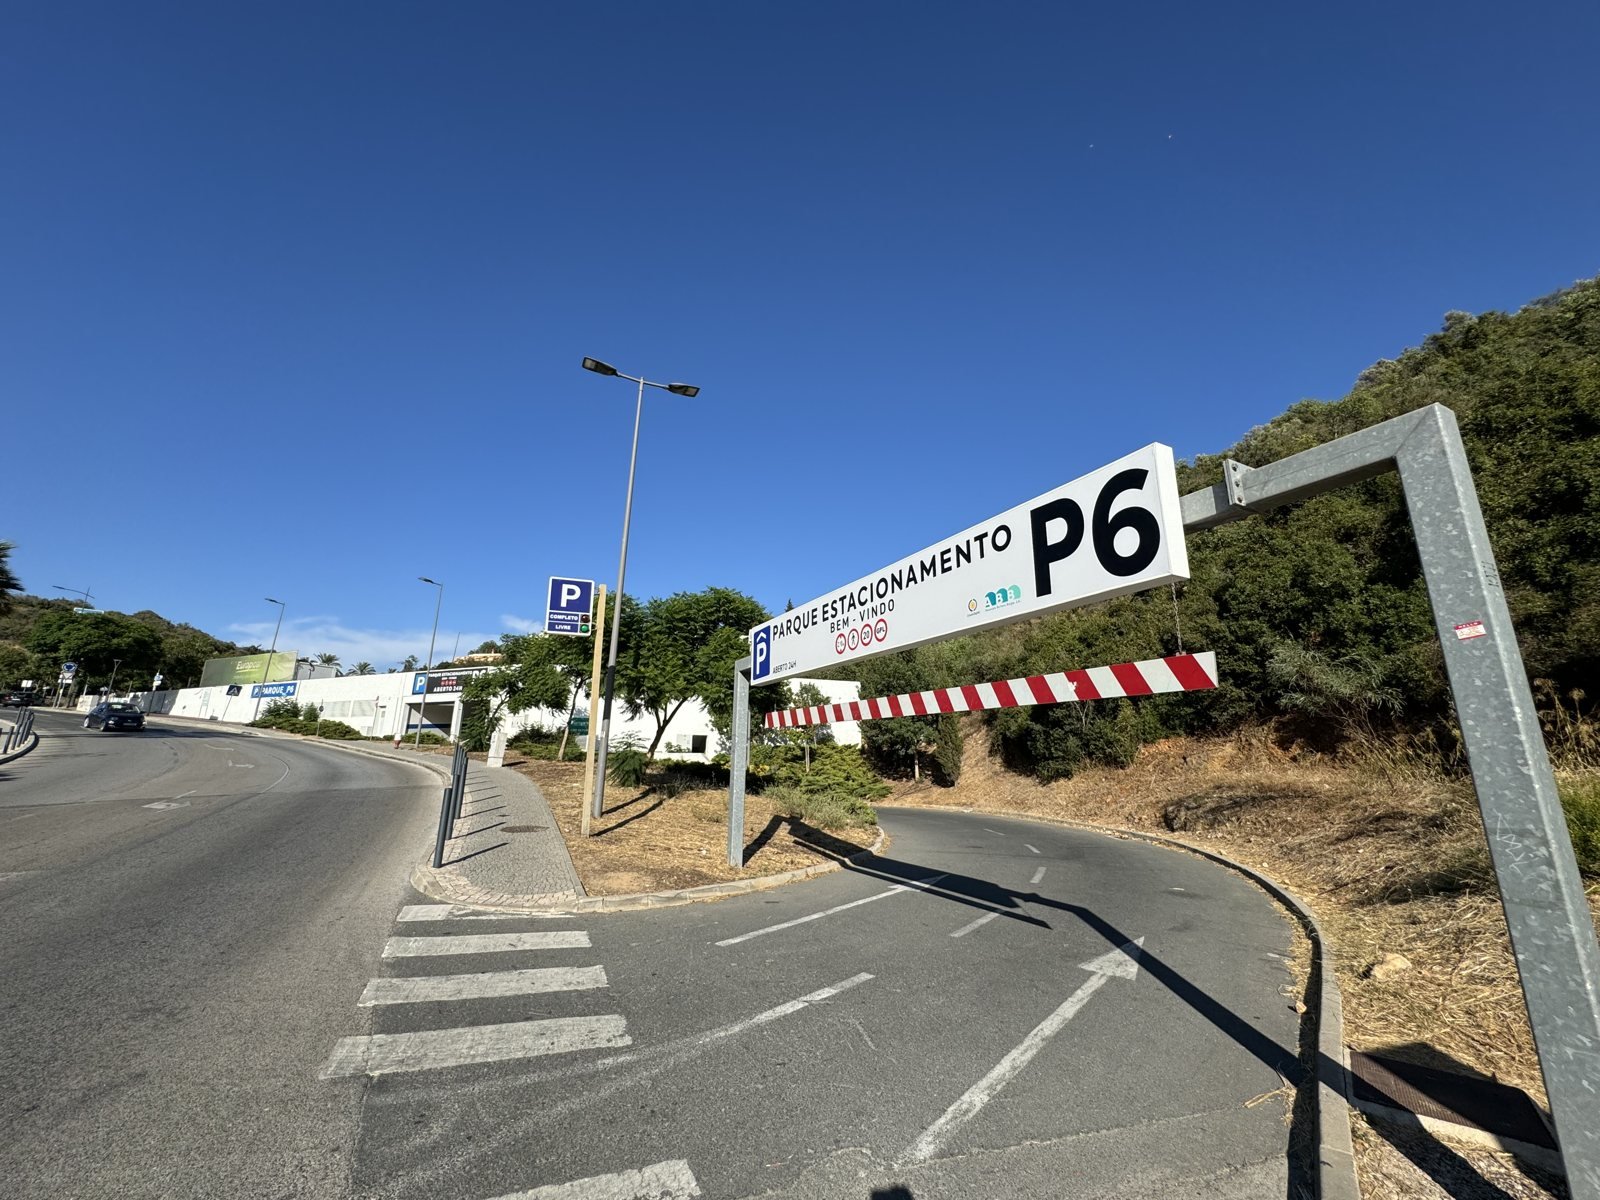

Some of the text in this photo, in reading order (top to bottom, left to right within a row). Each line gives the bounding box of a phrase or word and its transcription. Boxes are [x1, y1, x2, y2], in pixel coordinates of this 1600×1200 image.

[1030, 468, 1161, 598] P6
[560, 583, 581, 608] P
[772, 524, 1012, 641] PARQUE ESTACIONAMENTO
[830, 616, 849, 634] BEM
[859, 599, 895, 622] VINDO
[863, 630, 870, 640] 20
[756, 641, 767, 675] P
[772, 663, 789, 674] ABERTO
[416, 676, 425, 691] P
